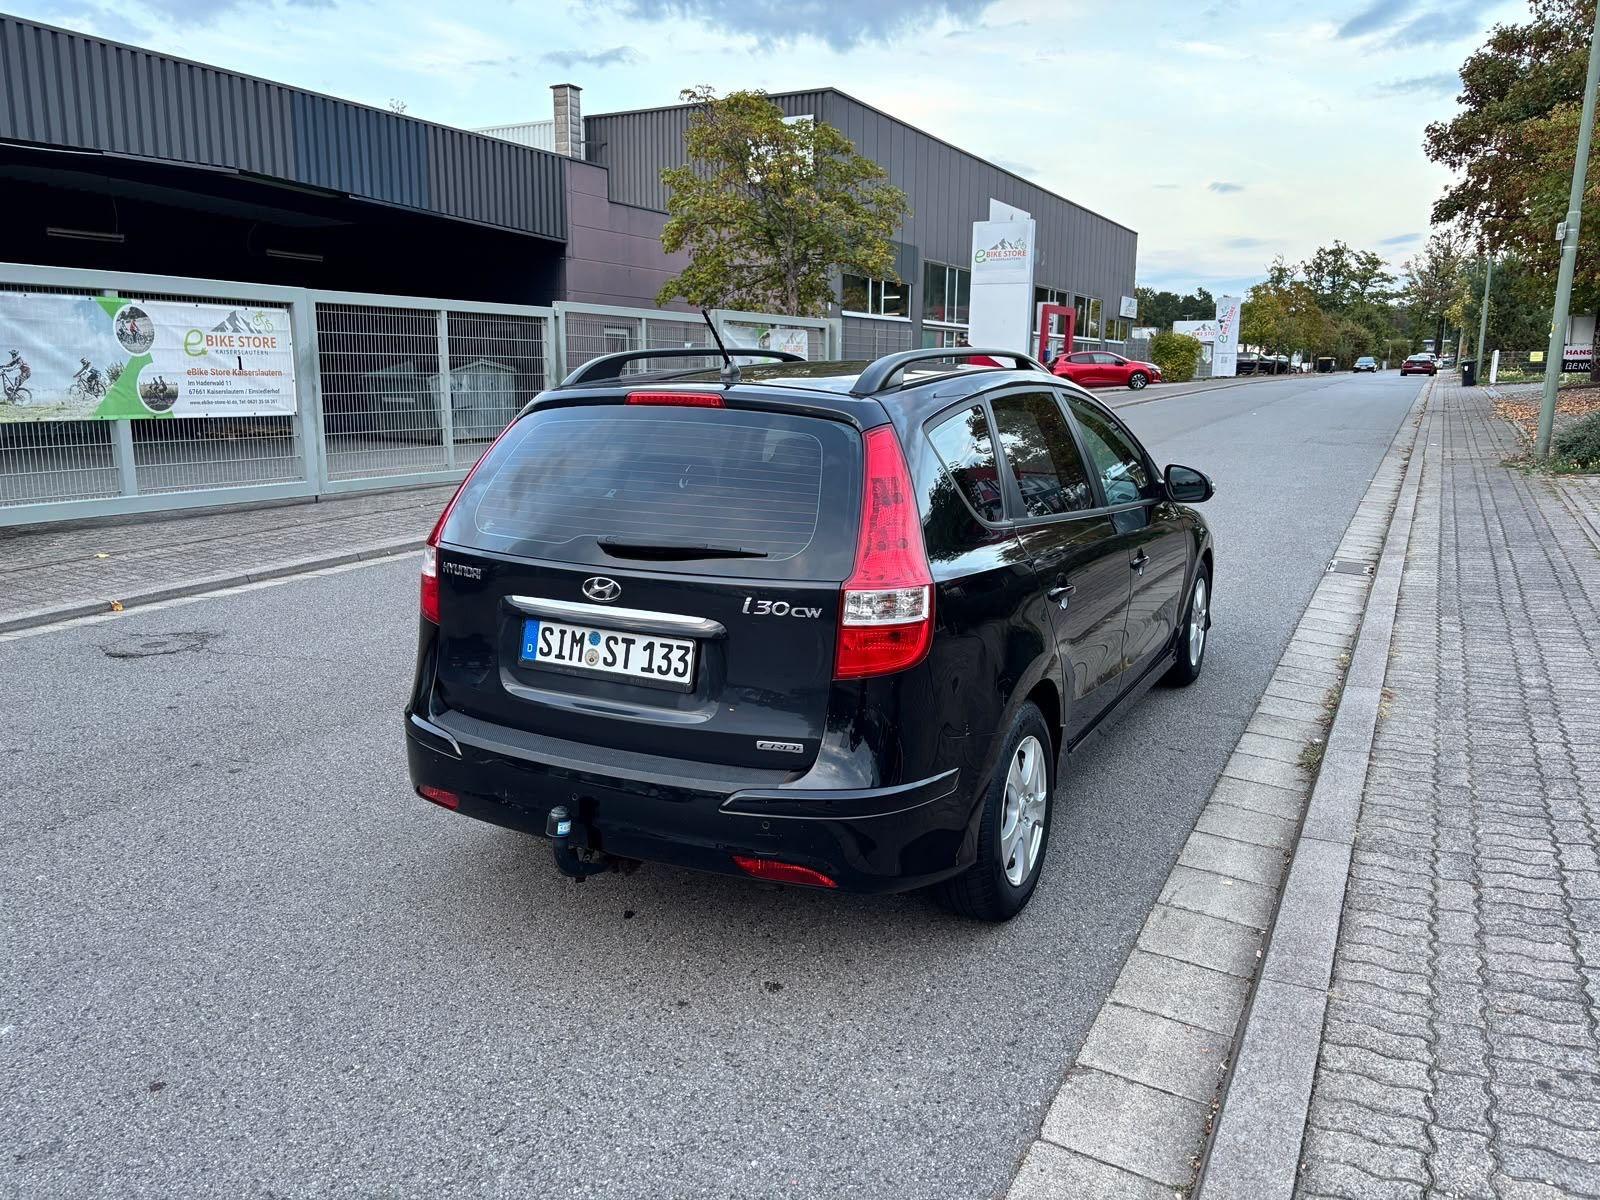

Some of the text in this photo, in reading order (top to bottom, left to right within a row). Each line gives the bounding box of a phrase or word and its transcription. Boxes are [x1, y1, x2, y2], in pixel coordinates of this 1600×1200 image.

[238, 336, 277, 348] STORE
[187, 368, 282, 376] eBike Store Kaiserslautern
[443, 562, 481, 579] HYUNDAI
[527, 643, 533, 652] D
[538, 626, 691, 678] SIM ST 133
